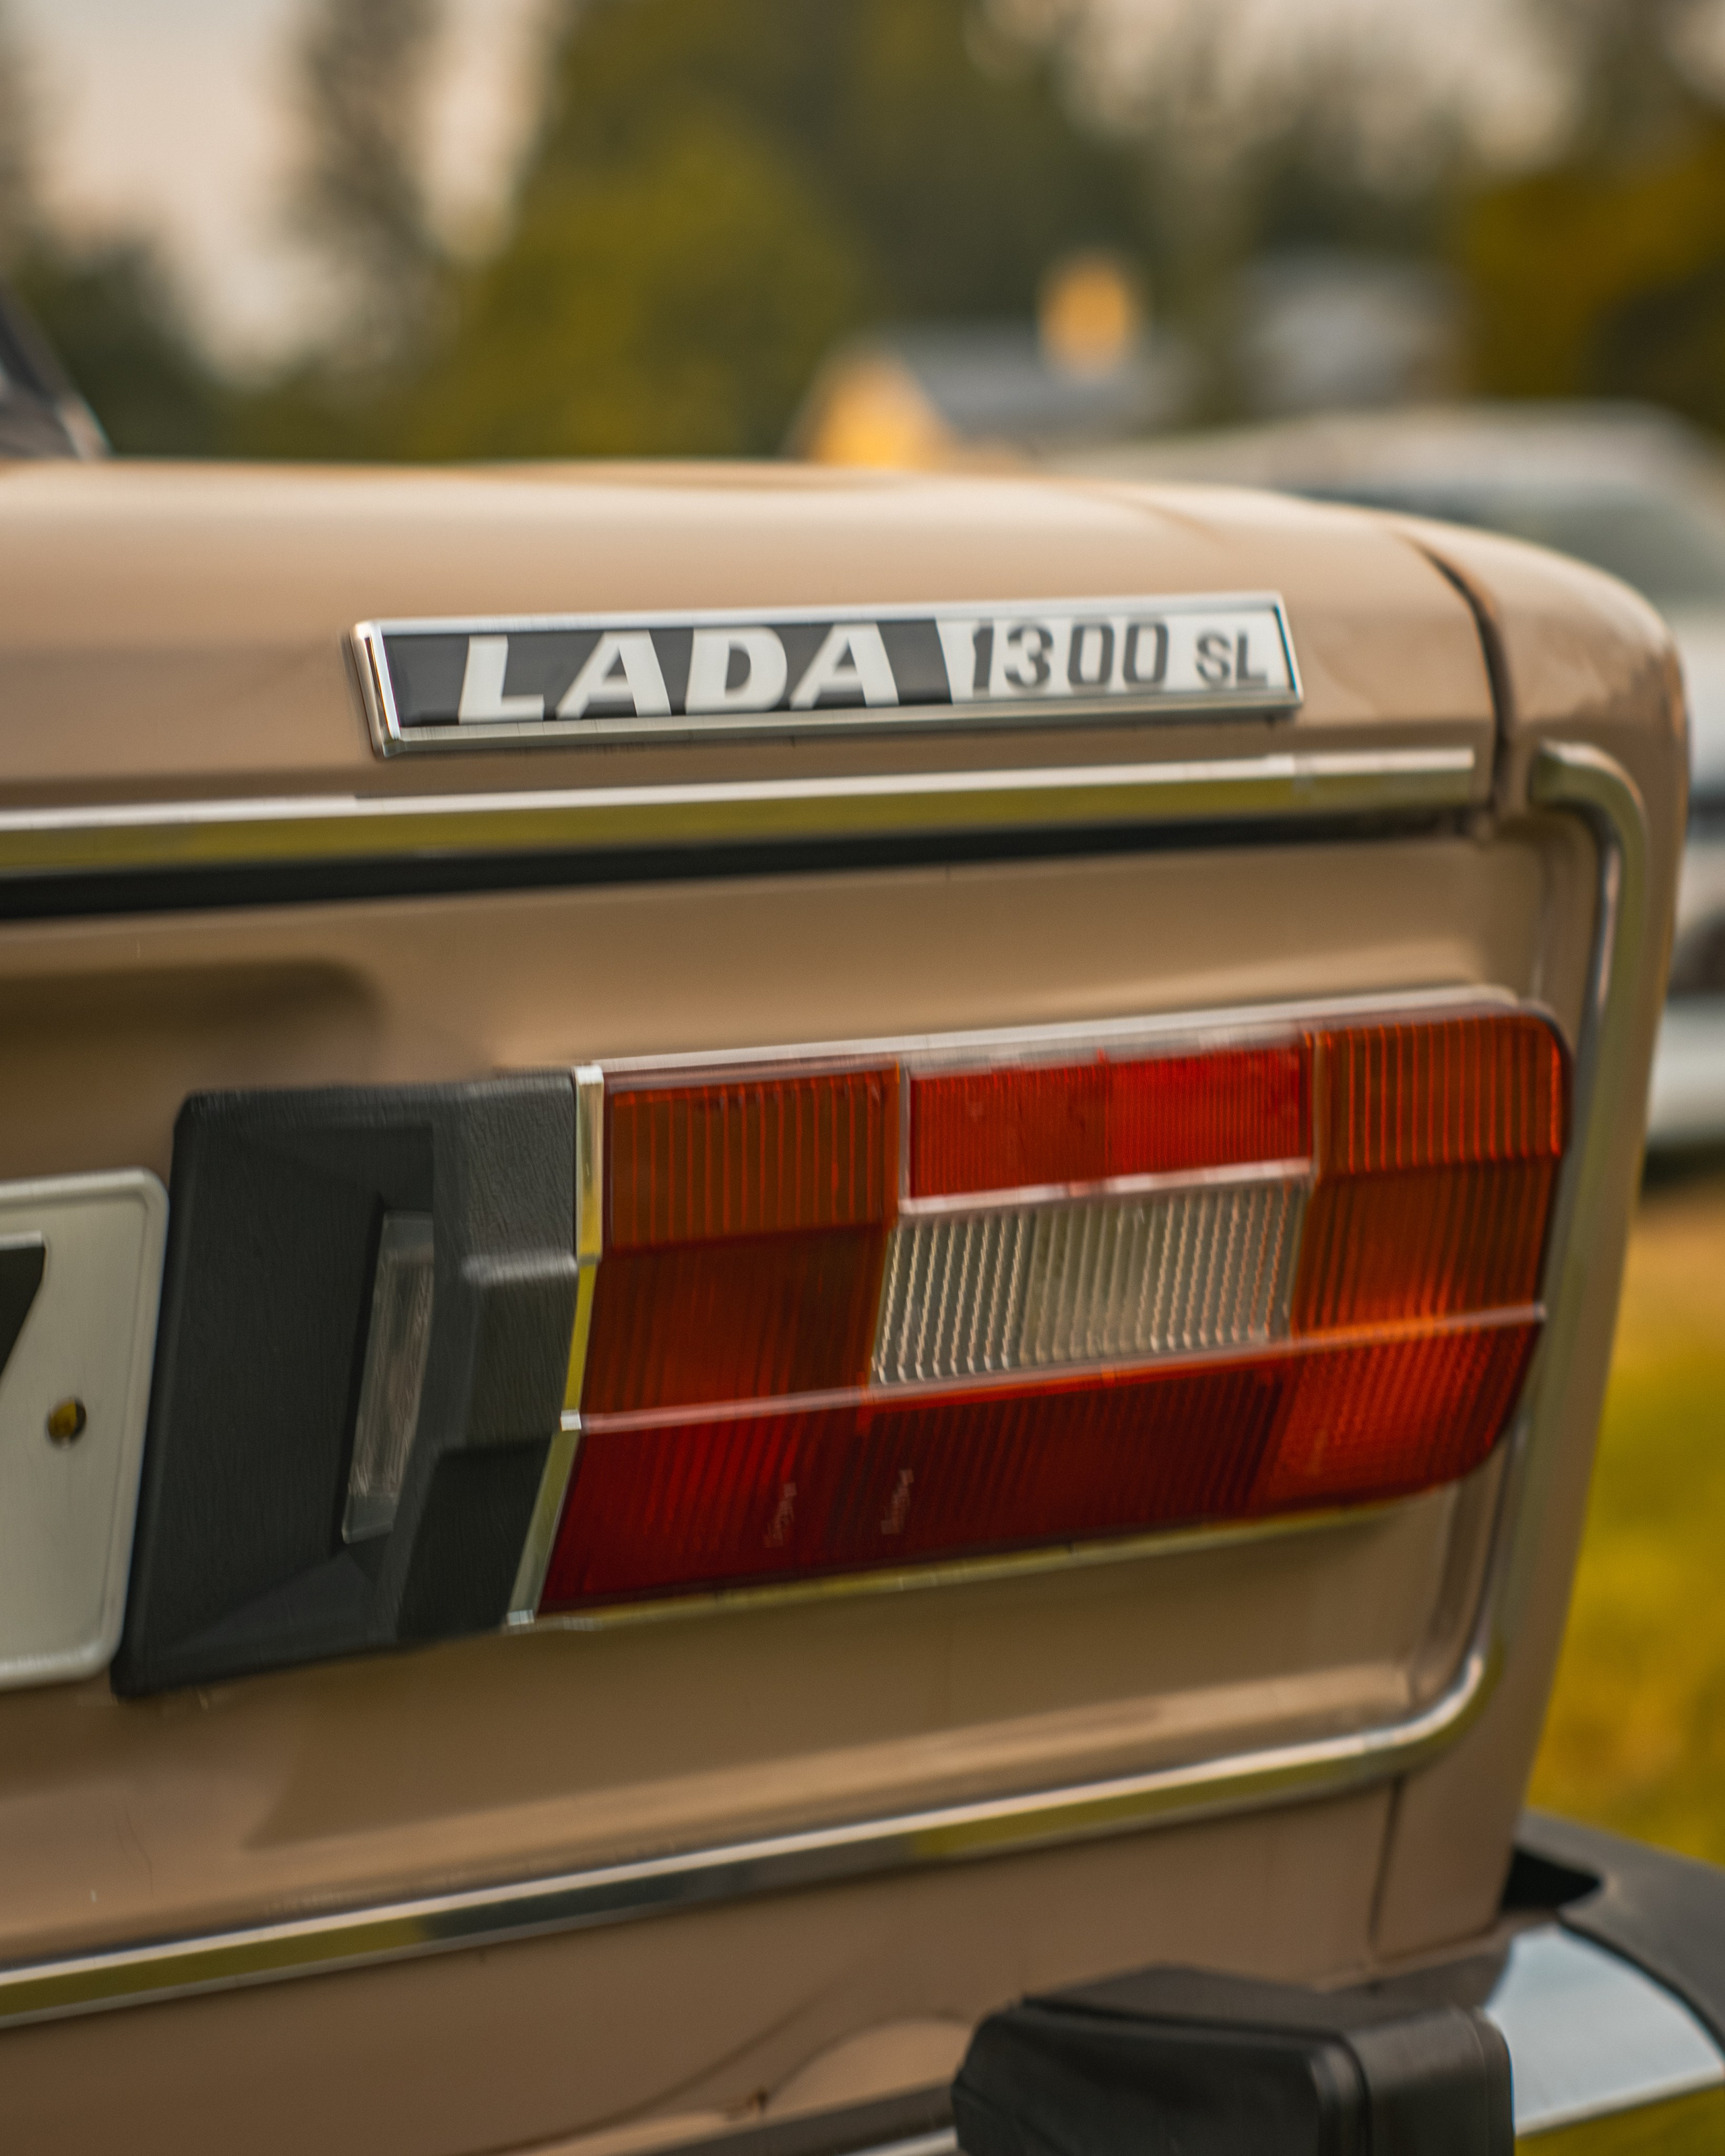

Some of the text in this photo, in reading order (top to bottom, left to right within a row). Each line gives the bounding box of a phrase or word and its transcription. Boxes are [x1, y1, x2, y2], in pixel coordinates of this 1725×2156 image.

[459, 618, 1269, 722] LADA 1300 SL
